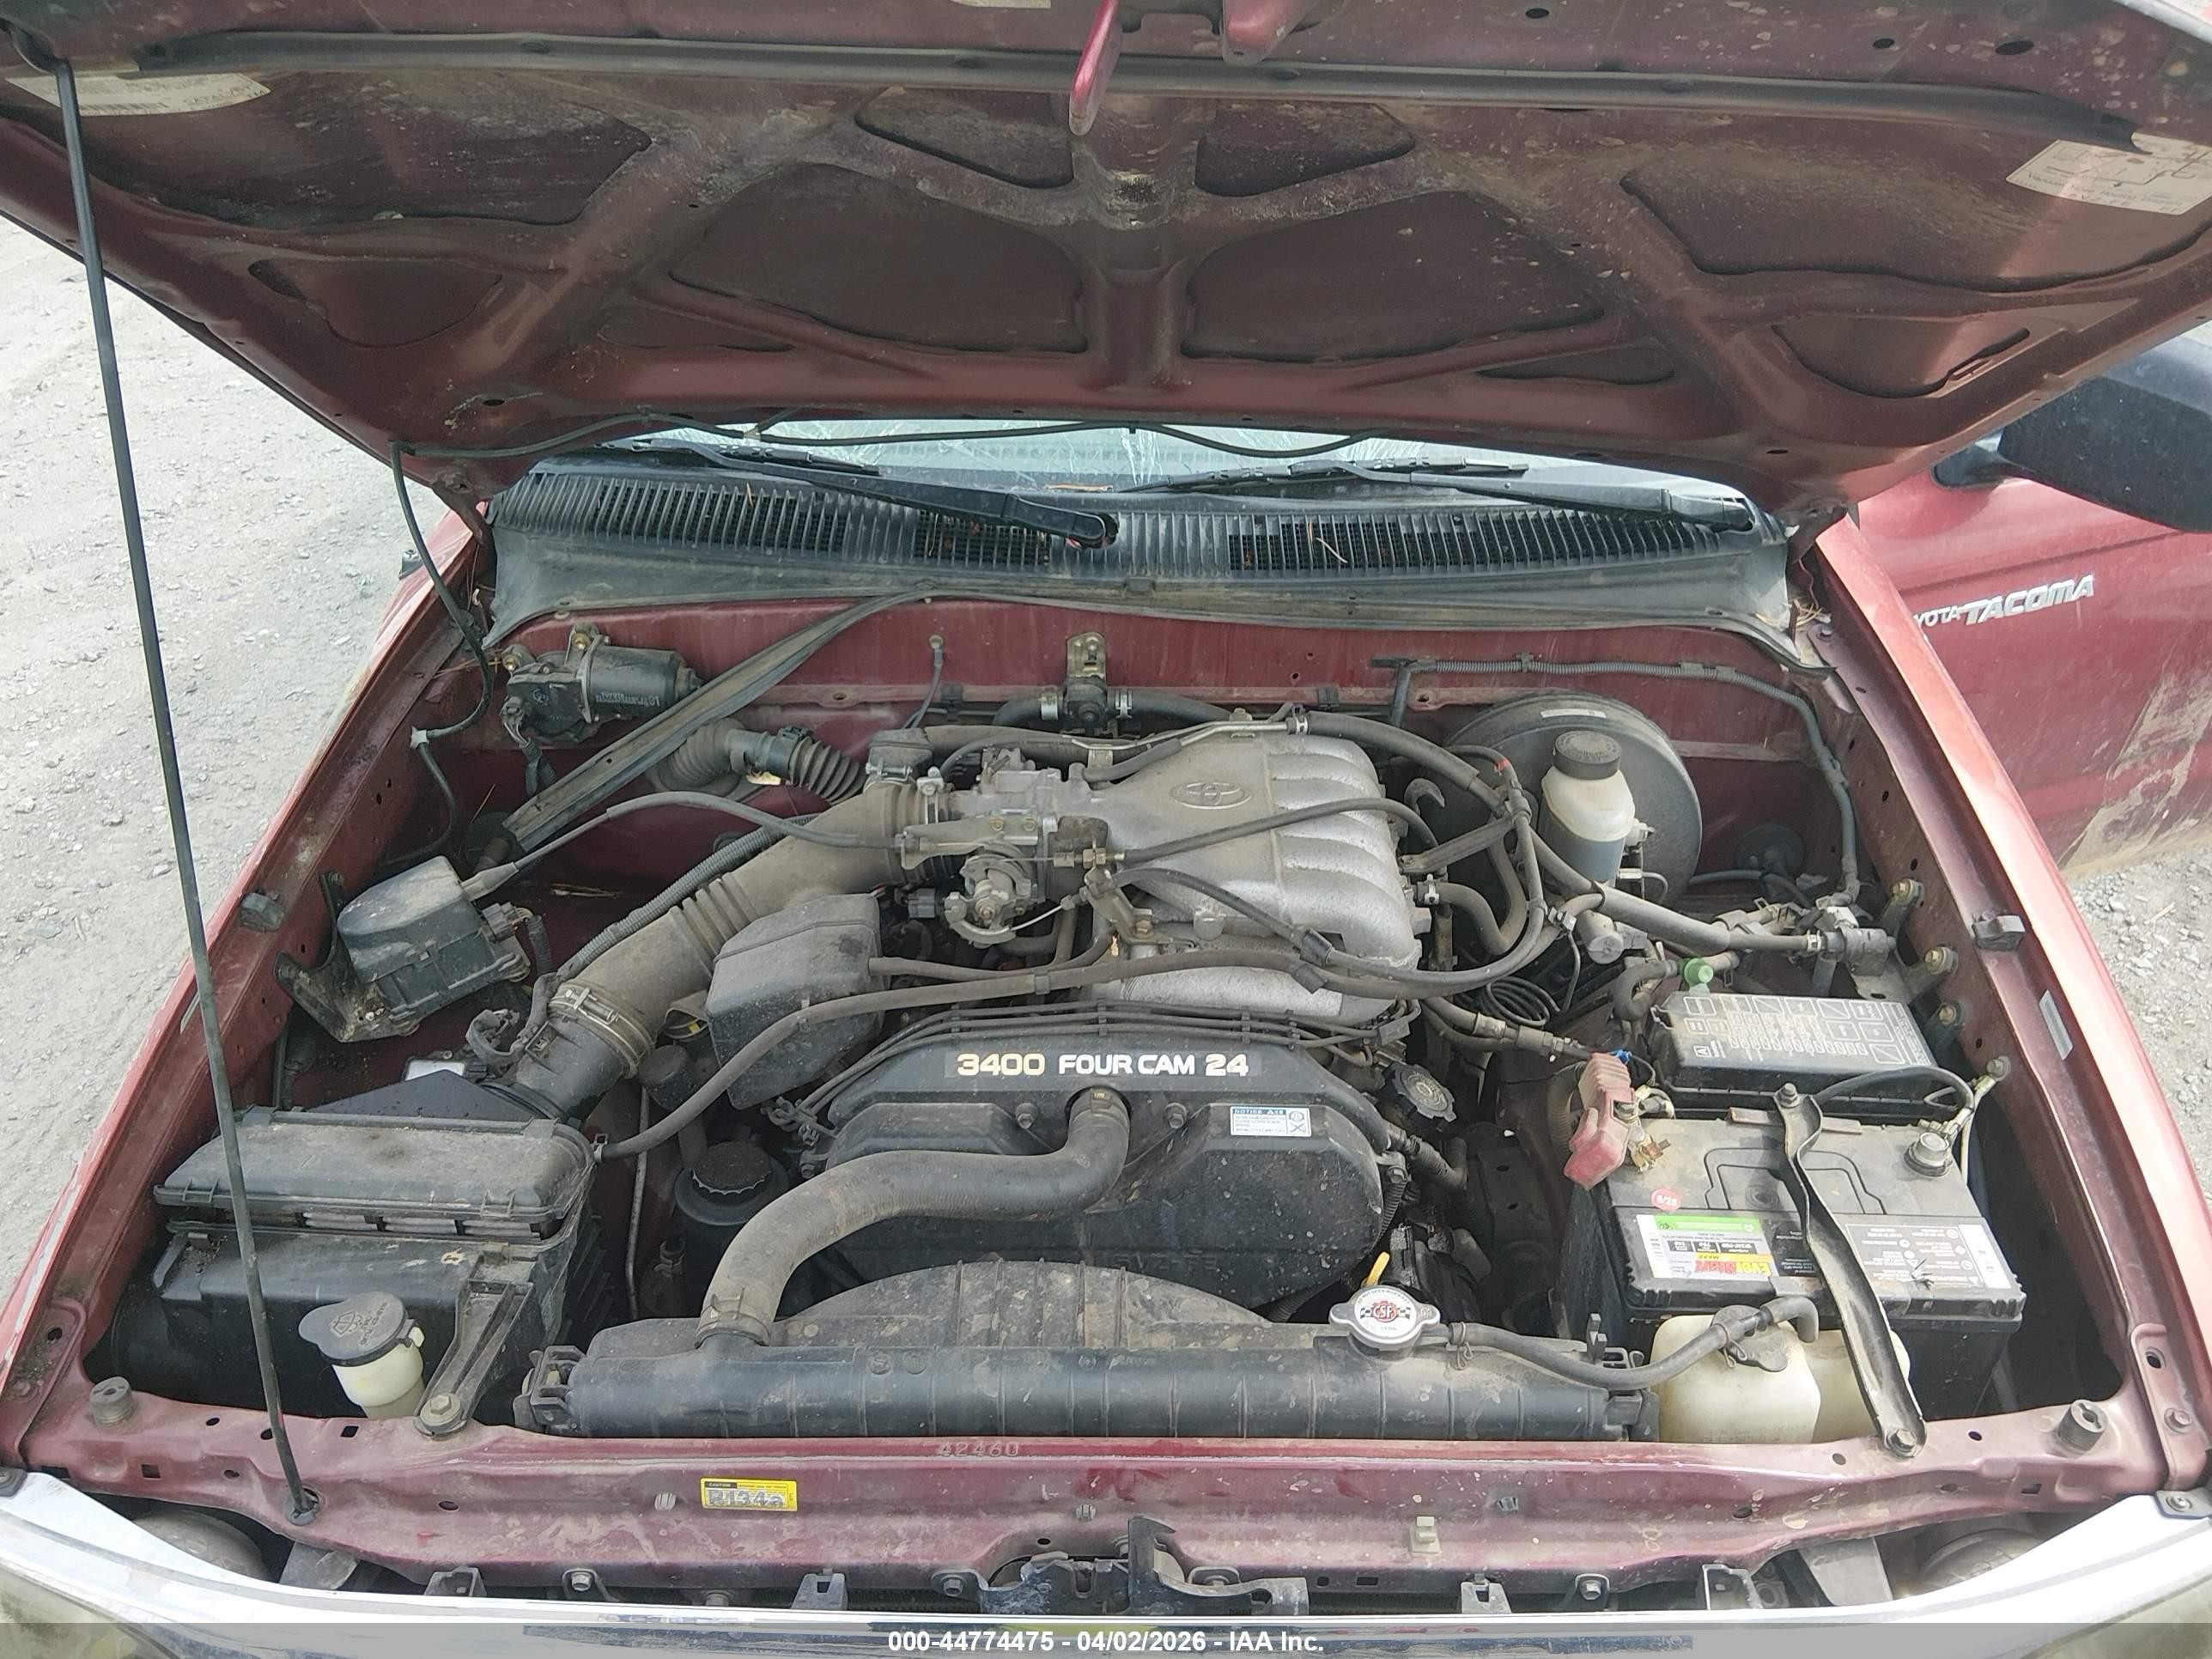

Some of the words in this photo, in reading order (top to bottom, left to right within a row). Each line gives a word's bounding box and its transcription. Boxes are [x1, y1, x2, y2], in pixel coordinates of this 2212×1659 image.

[1964, 574, 2094, 625] TACOMA
[957, 1052, 1046, 1077] 3400
[1058, 1054, 1133, 1076] FOUR
[1138, 1054, 1196, 1076] CAM
[1205, 1053, 1249, 1078] 24
[1372, 1304, 1394, 1318] CSF
[936, 1441, 1020, 1457] 42460
